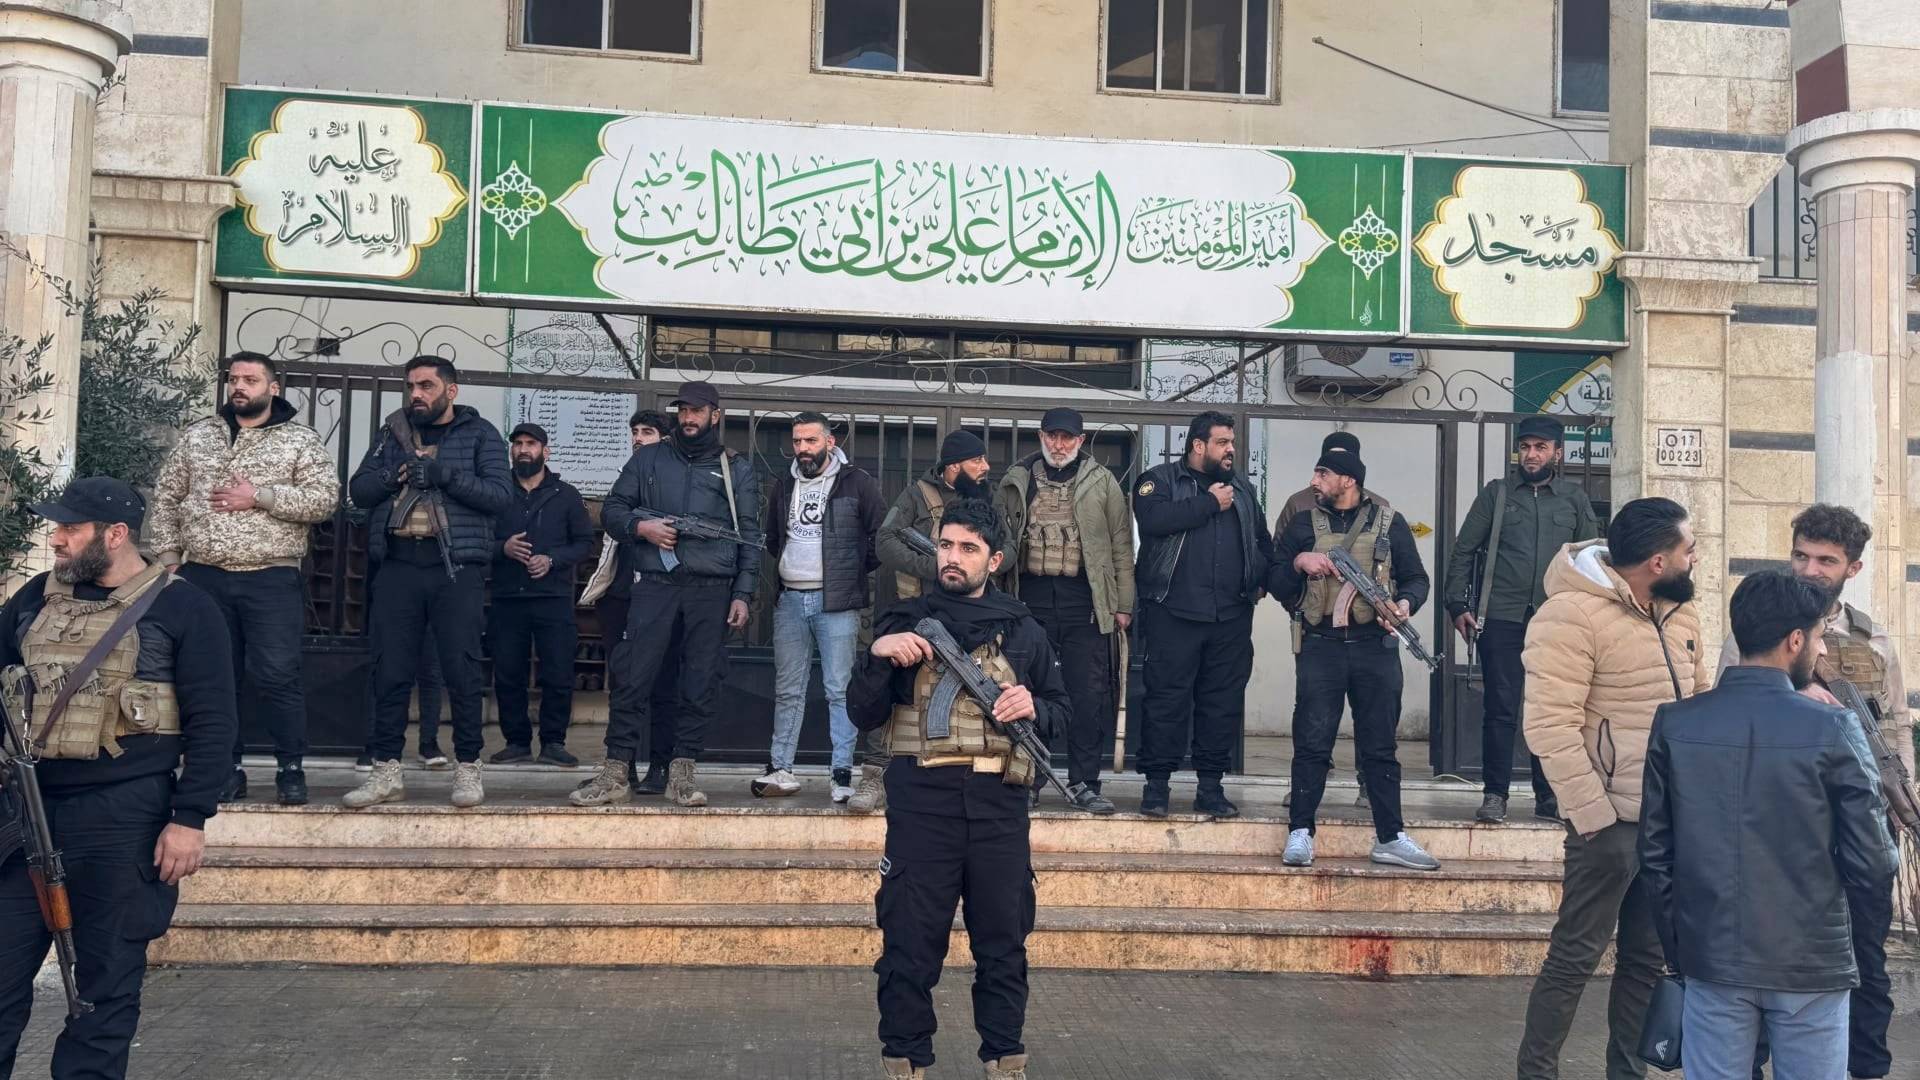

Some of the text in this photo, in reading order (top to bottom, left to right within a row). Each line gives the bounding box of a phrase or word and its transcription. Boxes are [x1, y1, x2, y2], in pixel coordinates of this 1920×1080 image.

[309, 120, 402, 183] عليه
[277, 188, 408, 248] السلام
[1127, 198, 1248, 272] المؤمنين
[1442, 212, 1598, 284] مسجد
[1661, 449, 1699, 462] 00223
